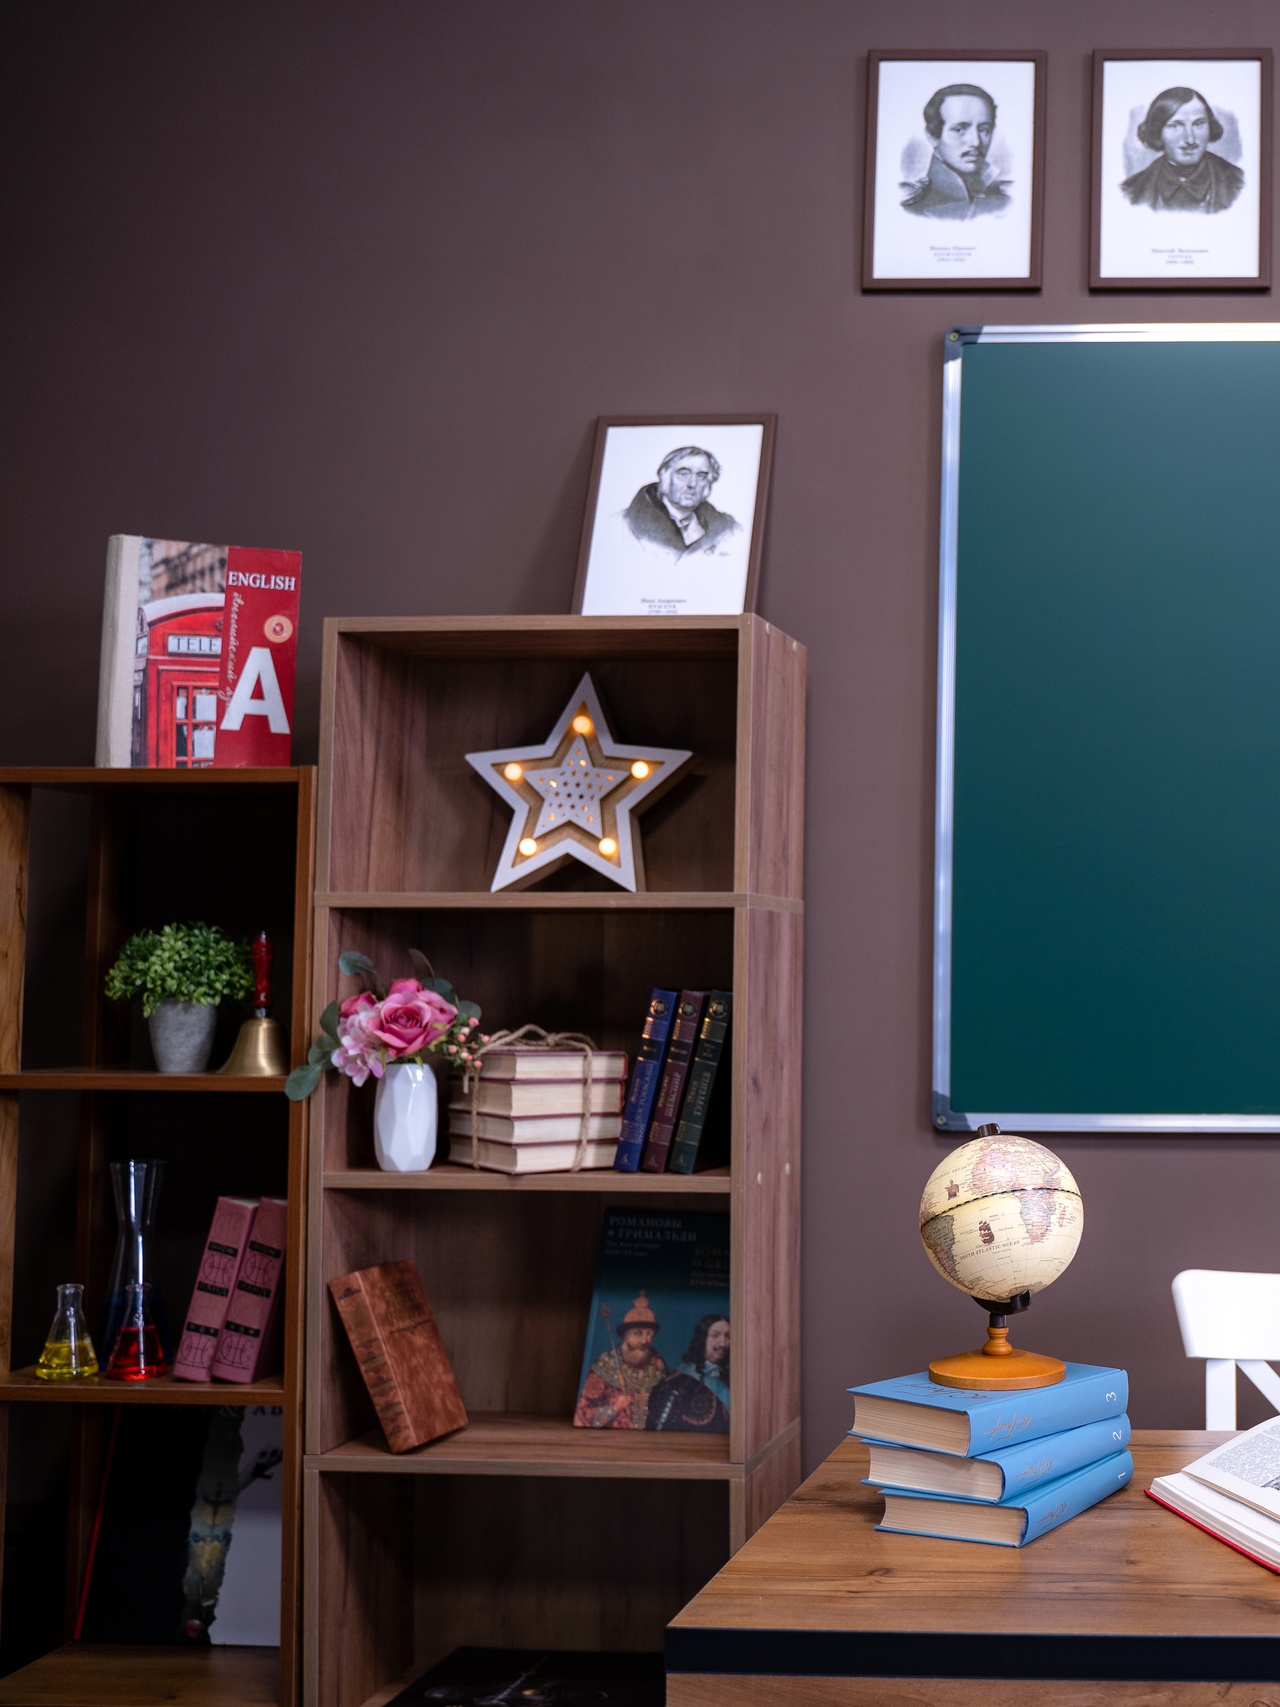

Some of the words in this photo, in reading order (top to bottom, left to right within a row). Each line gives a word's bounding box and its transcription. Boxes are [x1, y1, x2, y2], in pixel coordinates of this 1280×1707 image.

[228, 571, 296, 592] ENGLISH
[664, 1071, 681, 1118] ШЕКСПИР
[694, 1071, 712, 1116] ТУРГЕНЕВ
[610, 1216, 682, 1229] РОМАНОВЫ
[618, 1229, 697, 1242] ГРИМАЛЬДИ
[960, 1252, 974, 1260] SOUTH
[976, 1244, 1002, 1256] ATLANTIC
[1002, 1240, 1020, 1248] OCEAN
[1106, 1392, 1116, 1402] 3
[1112, 1430, 1122, 1440] 2
[1118, 1472, 1126, 1480] 1
